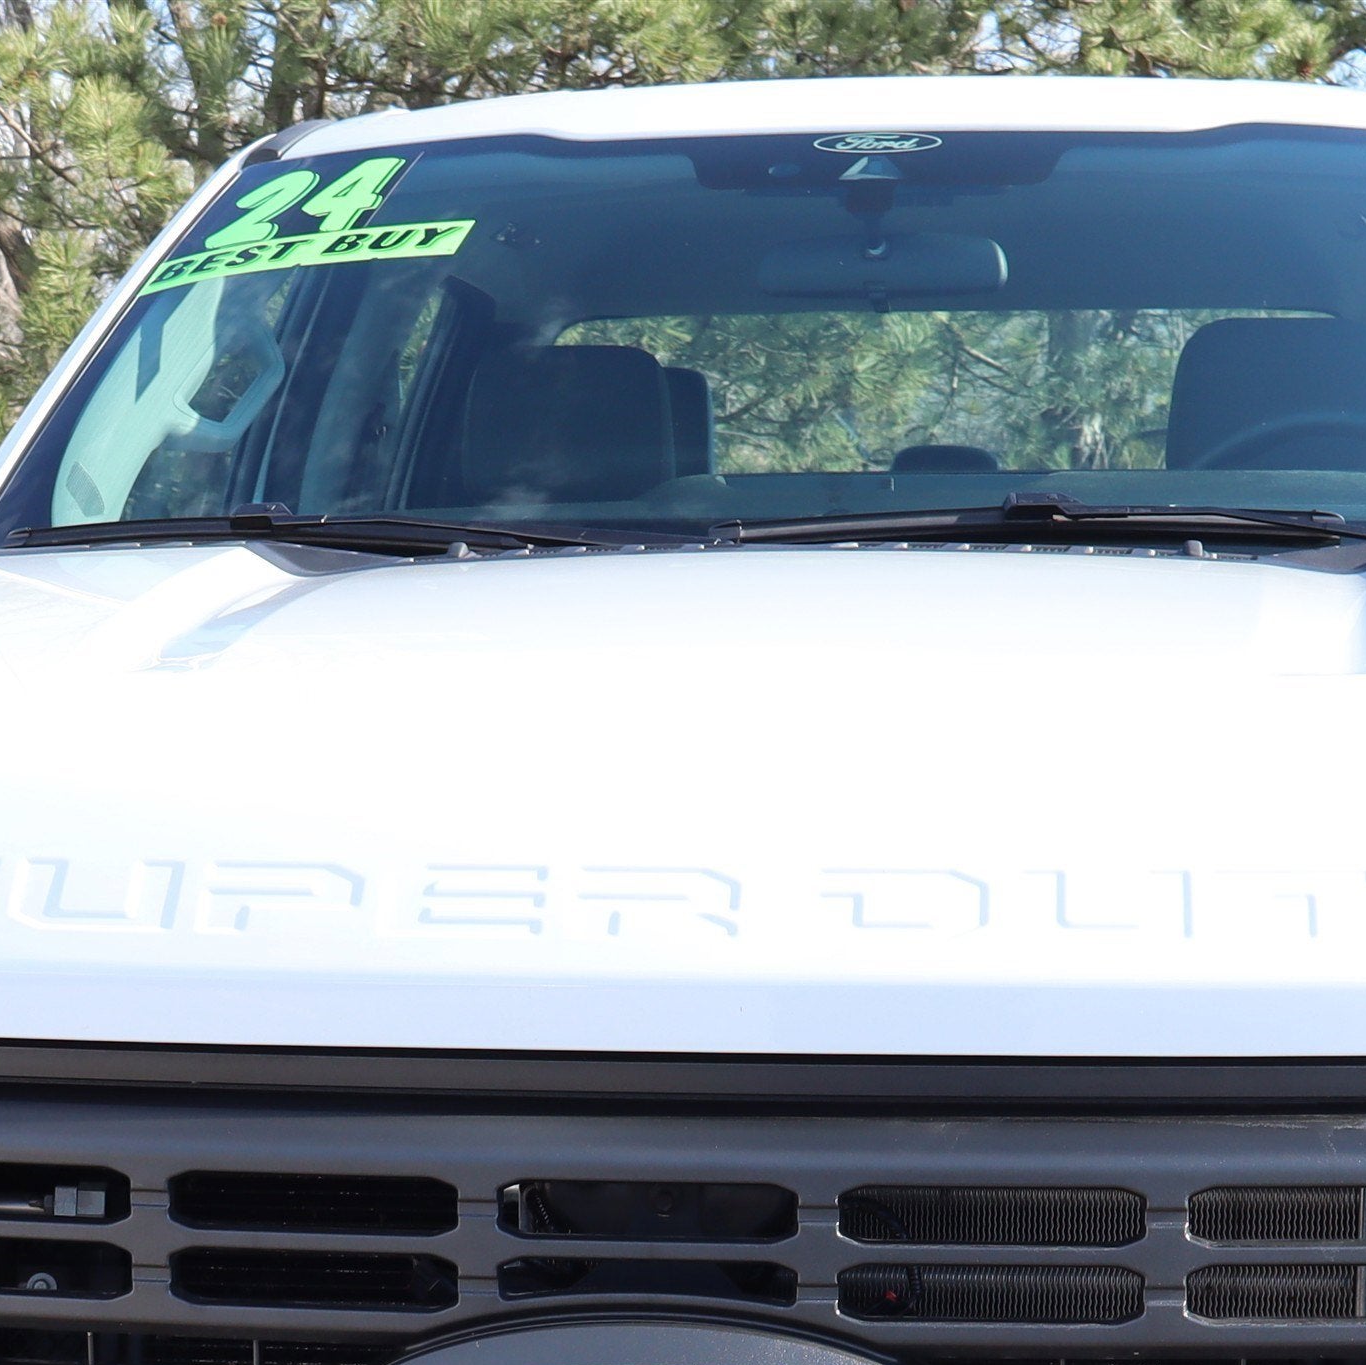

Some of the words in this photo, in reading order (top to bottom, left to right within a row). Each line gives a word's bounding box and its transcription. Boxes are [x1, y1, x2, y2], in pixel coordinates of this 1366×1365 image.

[835, 135, 920, 150] Ford
[204, 156, 407, 250] 24
[149, 238, 311, 285] BEST
[320, 225, 463, 255] BUY
